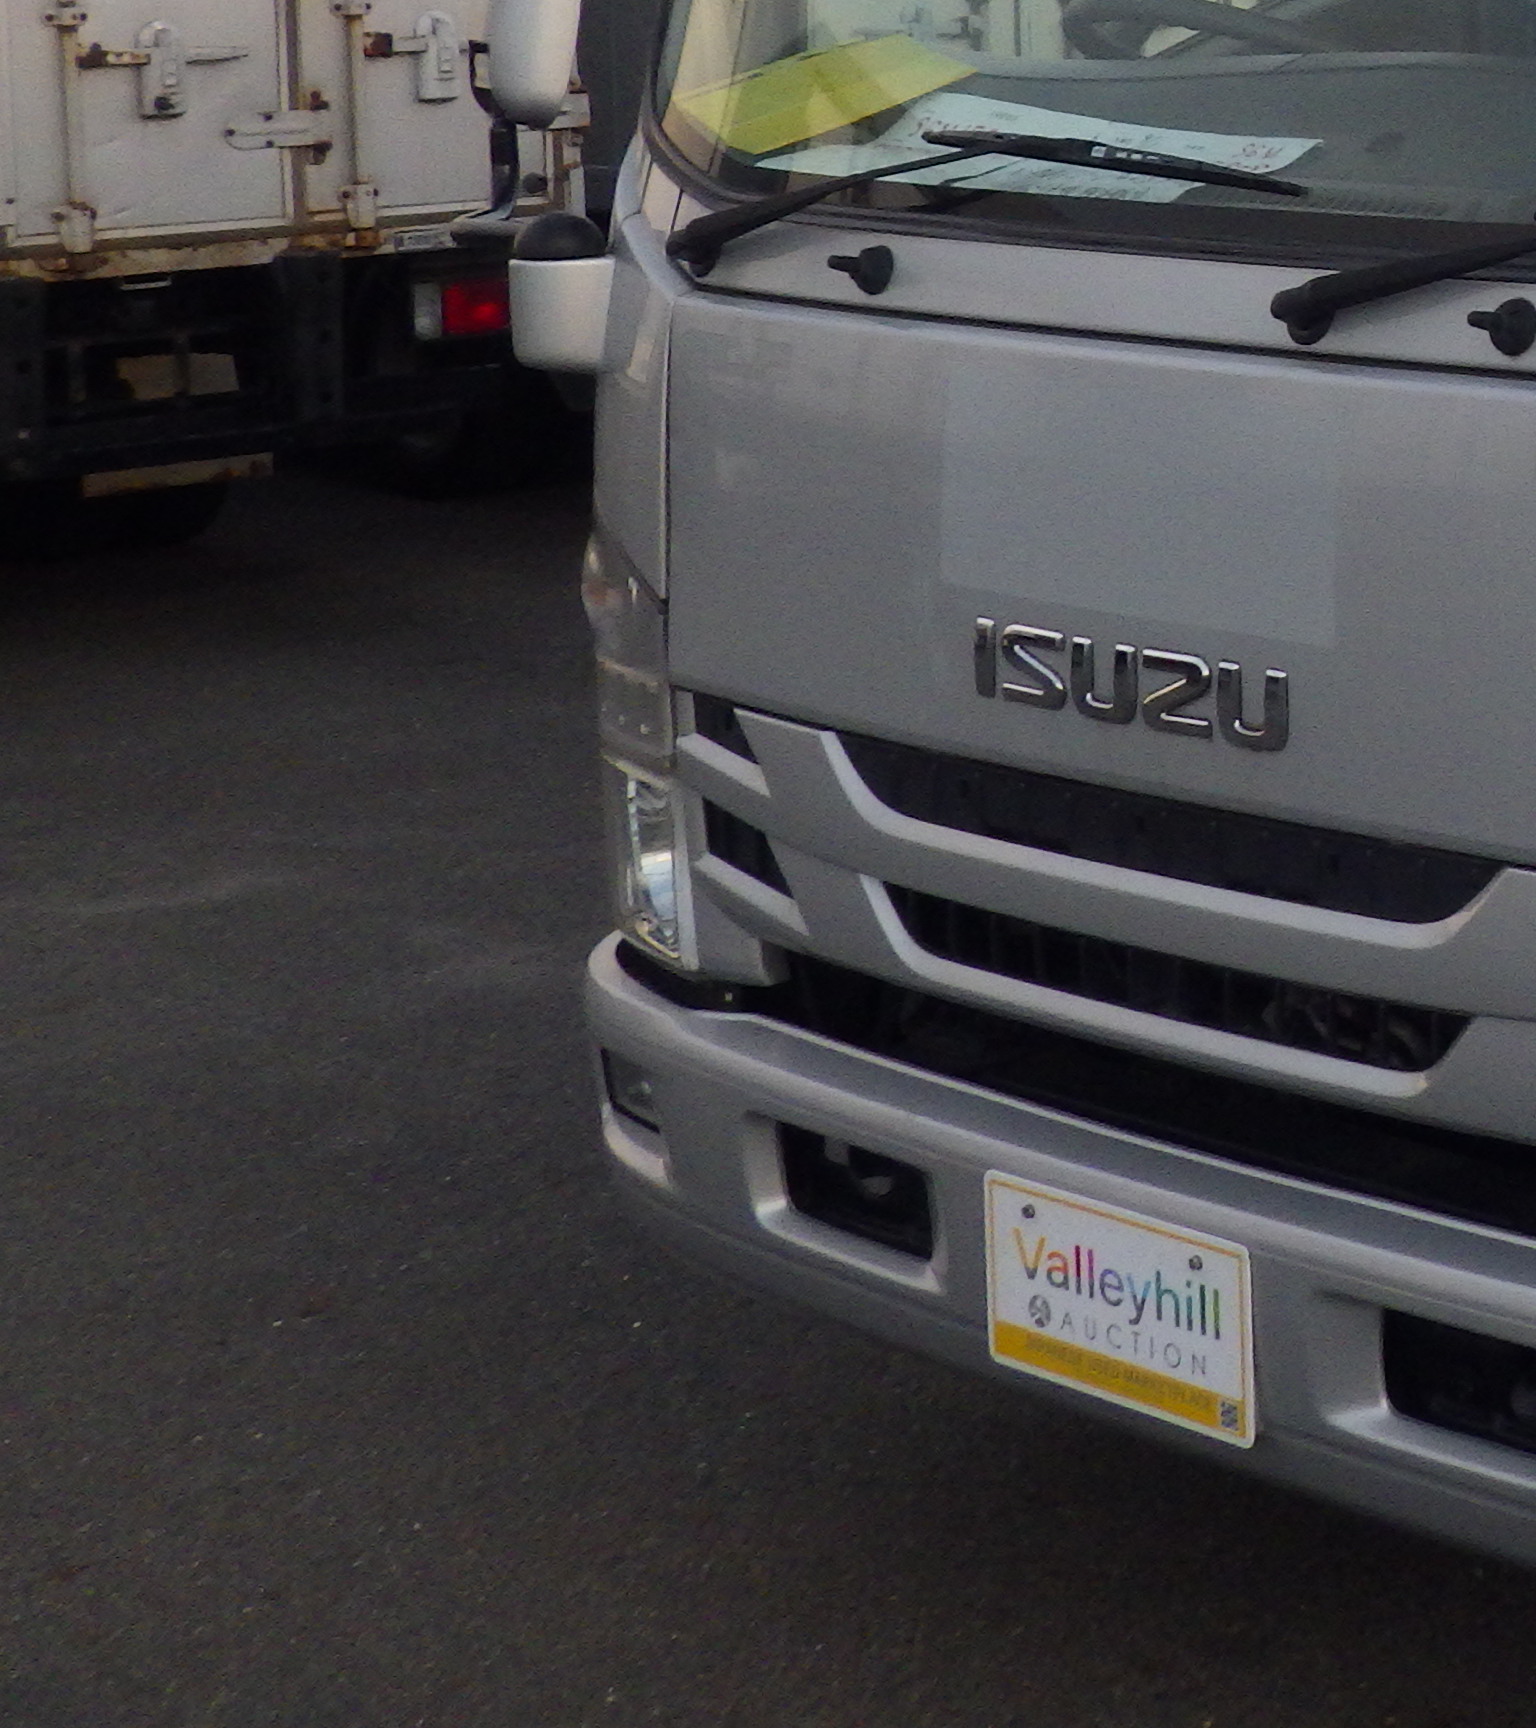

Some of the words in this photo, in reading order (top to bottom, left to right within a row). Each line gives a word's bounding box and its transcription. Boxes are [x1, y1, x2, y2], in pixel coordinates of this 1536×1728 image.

[973, 615, 1289, 752] ISUZU
[1011, 1227, 1221, 1340] Valleyhill
[1060, 1311, 1207, 1375] AUCTION
